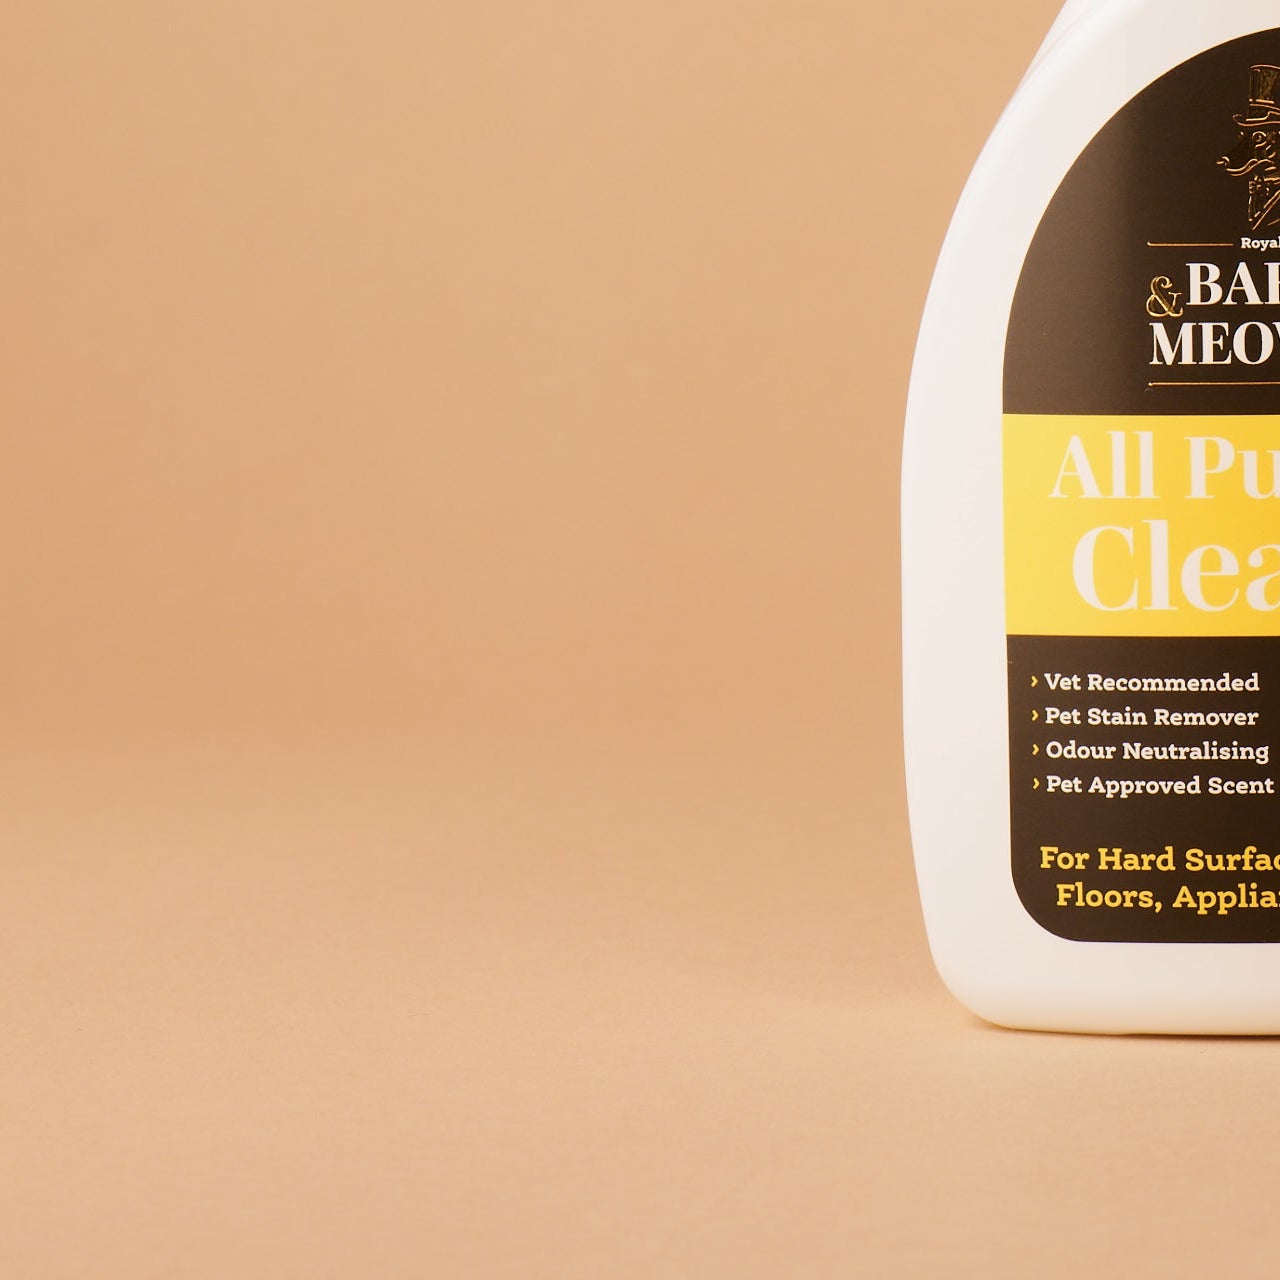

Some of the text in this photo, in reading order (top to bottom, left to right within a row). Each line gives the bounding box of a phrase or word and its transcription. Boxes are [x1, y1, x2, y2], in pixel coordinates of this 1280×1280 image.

[1145, 275, 1184, 318] &
[1048, 430, 1158, 499] All
[1043, 671, 1261, 692] Vet Recommended
[1044, 705, 1260, 727] Pet Stain Remover
[1045, 739, 1270, 765] Odour Neutralising
[1046, 774, 1275, 799] Pet Approved Scent
[1039, 845, 1091, 870] For
[1097, 845, 1177, 872] Hard
[1055, 881, 1163, 914] Floors,
